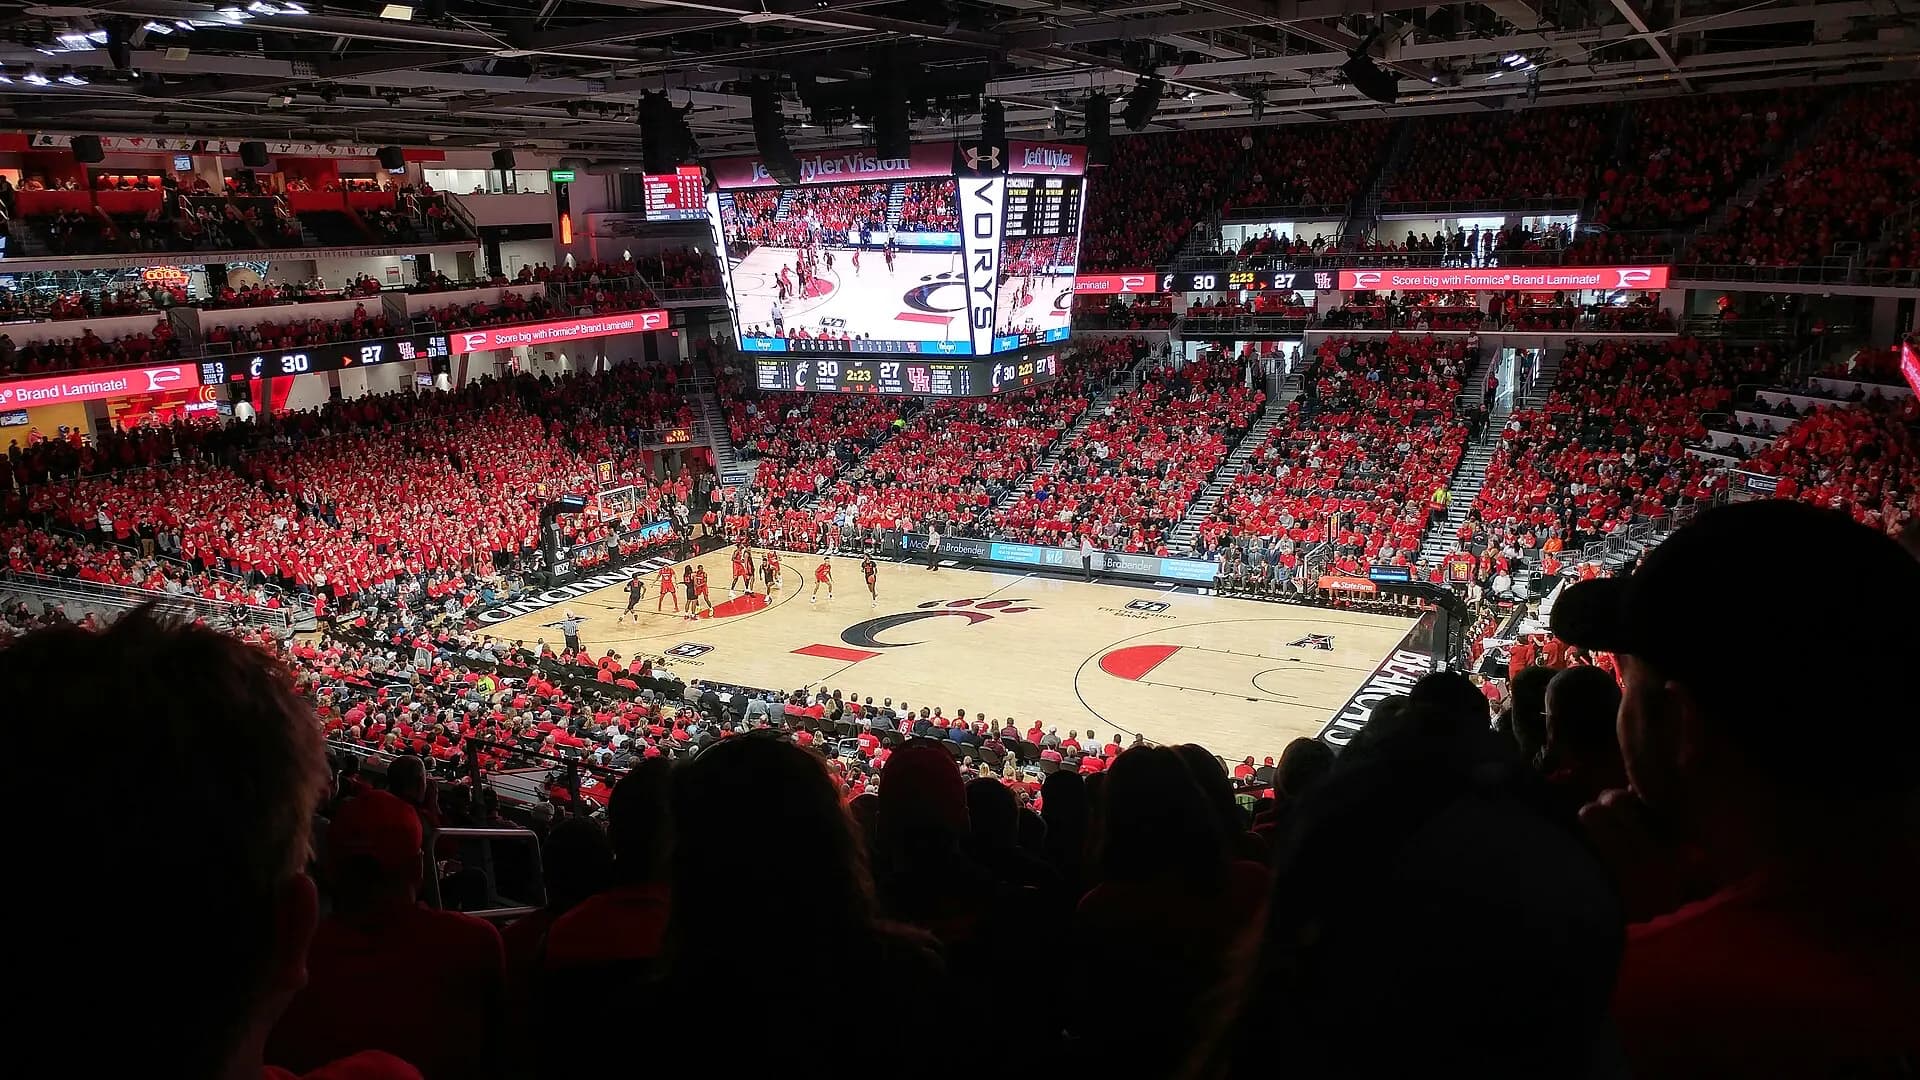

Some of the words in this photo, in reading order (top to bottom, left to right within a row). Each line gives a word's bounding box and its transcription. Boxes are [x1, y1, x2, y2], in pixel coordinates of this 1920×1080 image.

[1022, 147, 1044, 168] Jeff
[1044, 148, 1072, 171] Wyler
[974, 180, 993, 329] VORYS
[1193, 275, 1215, 290] 30
[1229, 273, 1254, 283] 2:23
[1274, 274, 1296, 289] 27
[1392, 276, 1420, 285] Score
[1423, 275, 1439, 286] big
[1442, 275, 1461, 285] with
[1512, 275, 1544, 285] Brand
[1547, 274, 1600, 285] Laminate!
[496, 334, 518, 345] Score
[519, 333, 531, 342] big
[533, 329, 547, 339] with
[581, 323, 601, 333] Brand
[603, 319, 634, 331] Laminate!
[361, 345, 382, 363] 27
[426, 347, 436, 358] 10
[215, 362, 223, 373] 3
[281, 354, 308, 373] 30
[817, 361, 838, 377] 30
[880, 362, 900, 378] 27
[1018, 363, 1033, 377] 2:23
[1036, 359, 1047, 374] 27
[217, 373, 224, 384] 7
[846, 369, 871, 381] 2:23
[1003, 365, 1015, 381] 30
[16, 383, 59, 402] Brand
[62, 378, 127, 396] Laminate!
[478, 556, 678, 624] CINCINNATI
